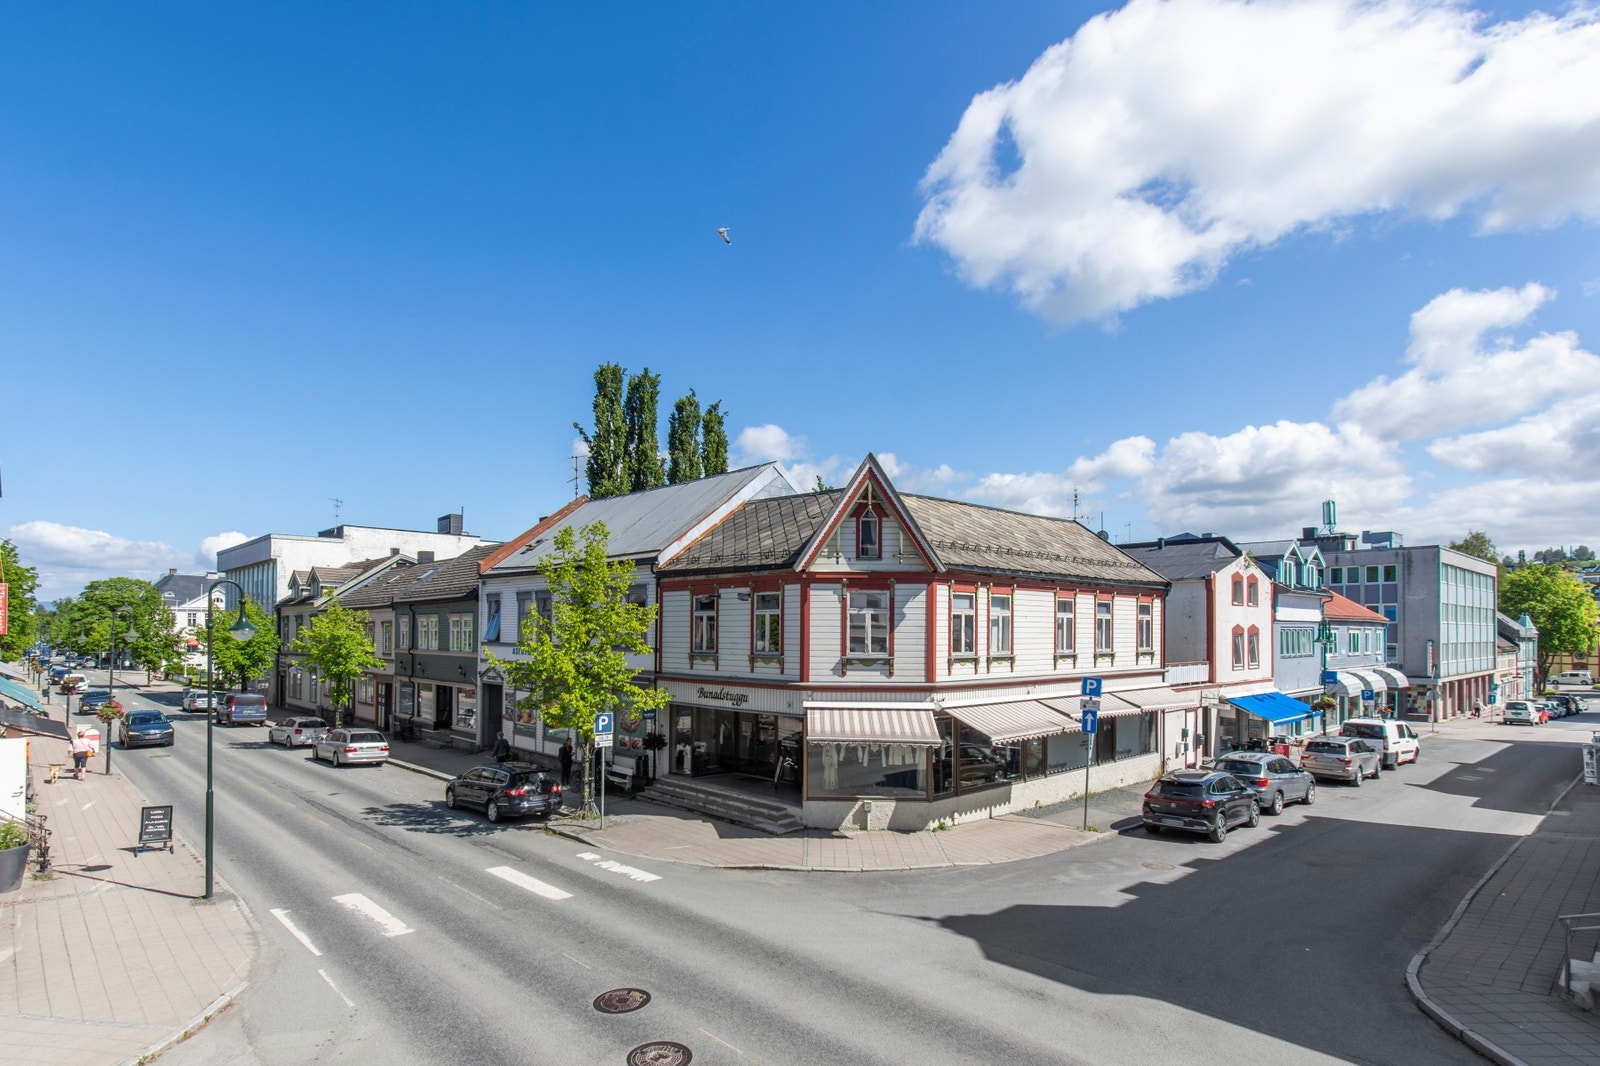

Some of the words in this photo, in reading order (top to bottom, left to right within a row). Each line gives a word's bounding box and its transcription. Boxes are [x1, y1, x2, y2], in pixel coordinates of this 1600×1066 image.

[1086, 680, 1097, 694] P
[1364, 690, 1371, 699] P
[697, 686, 749, 706] Bunadstuggu
[598, 715, 609, 731] P
